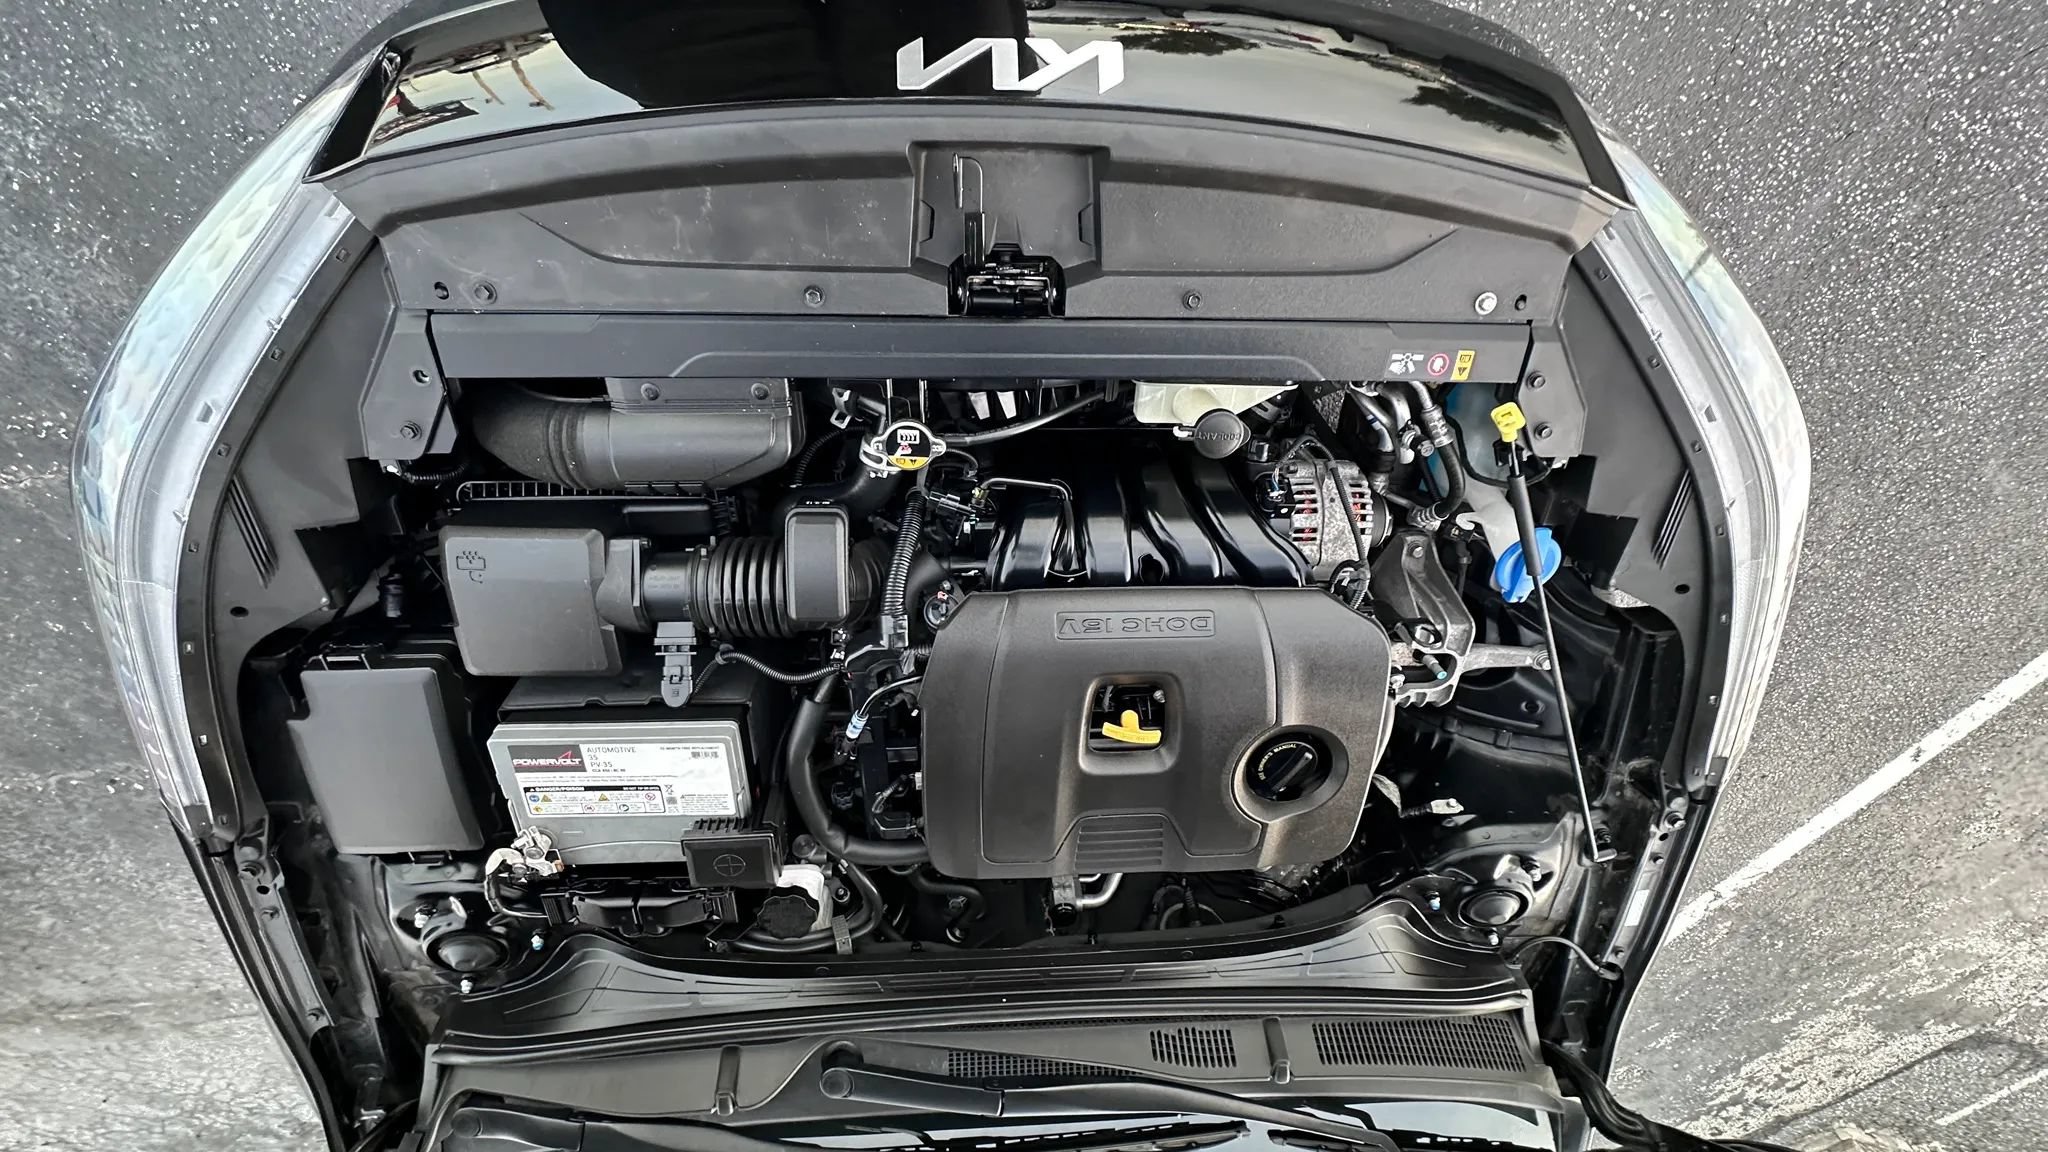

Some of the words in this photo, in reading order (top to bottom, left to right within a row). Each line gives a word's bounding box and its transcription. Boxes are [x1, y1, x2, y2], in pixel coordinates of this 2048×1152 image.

[896, 36, 1124, 94] KIA
[1196, 431, 1241, 441] COOLANT
[1059, 617, 1113, 635] 16V
[1121, 616, 1212, 633] DOHC
[1273, 743, 1297, 753] MANUAL
[512, 757, 583, 766] POWERVOLT
